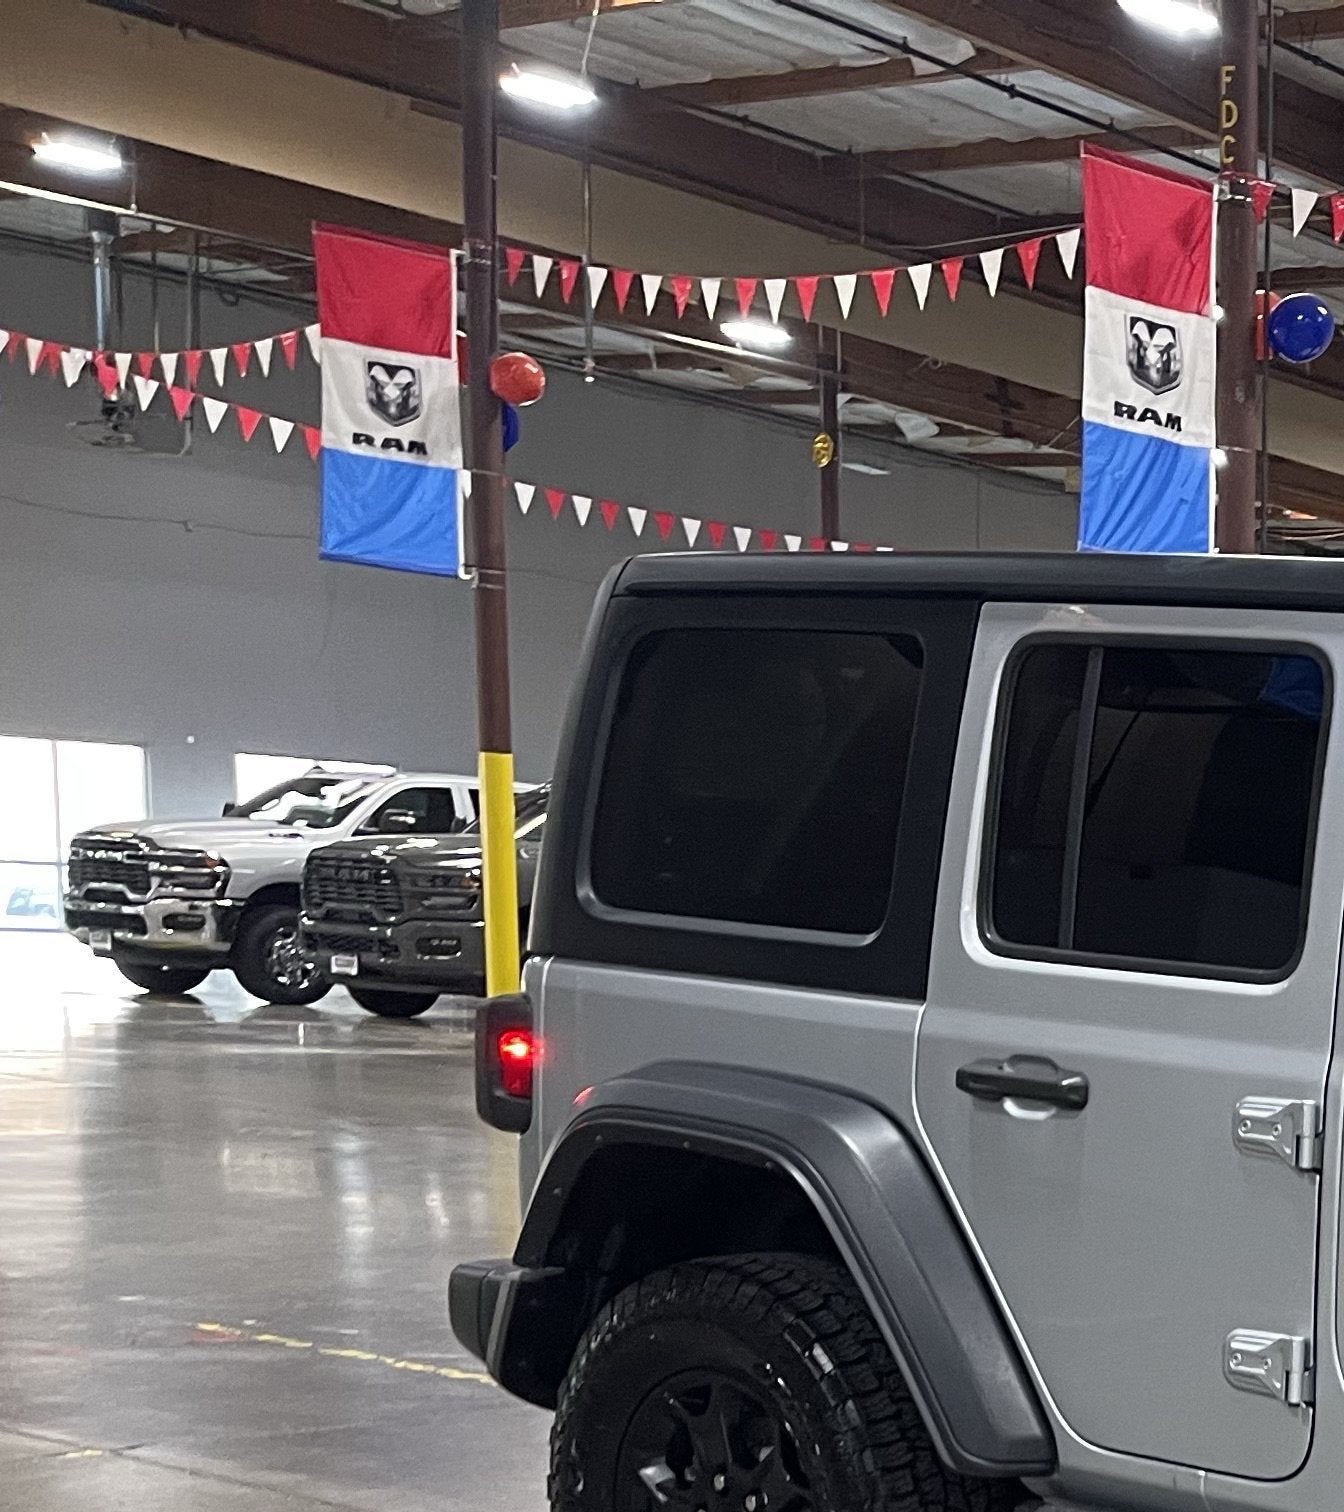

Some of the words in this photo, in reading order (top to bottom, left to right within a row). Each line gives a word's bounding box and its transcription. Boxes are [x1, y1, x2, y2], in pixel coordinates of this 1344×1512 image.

[1221, 65, 1238, 163] FDC
[1114, 400, 1182, 432] RAM
[352, 432, 428, 456] RAM
